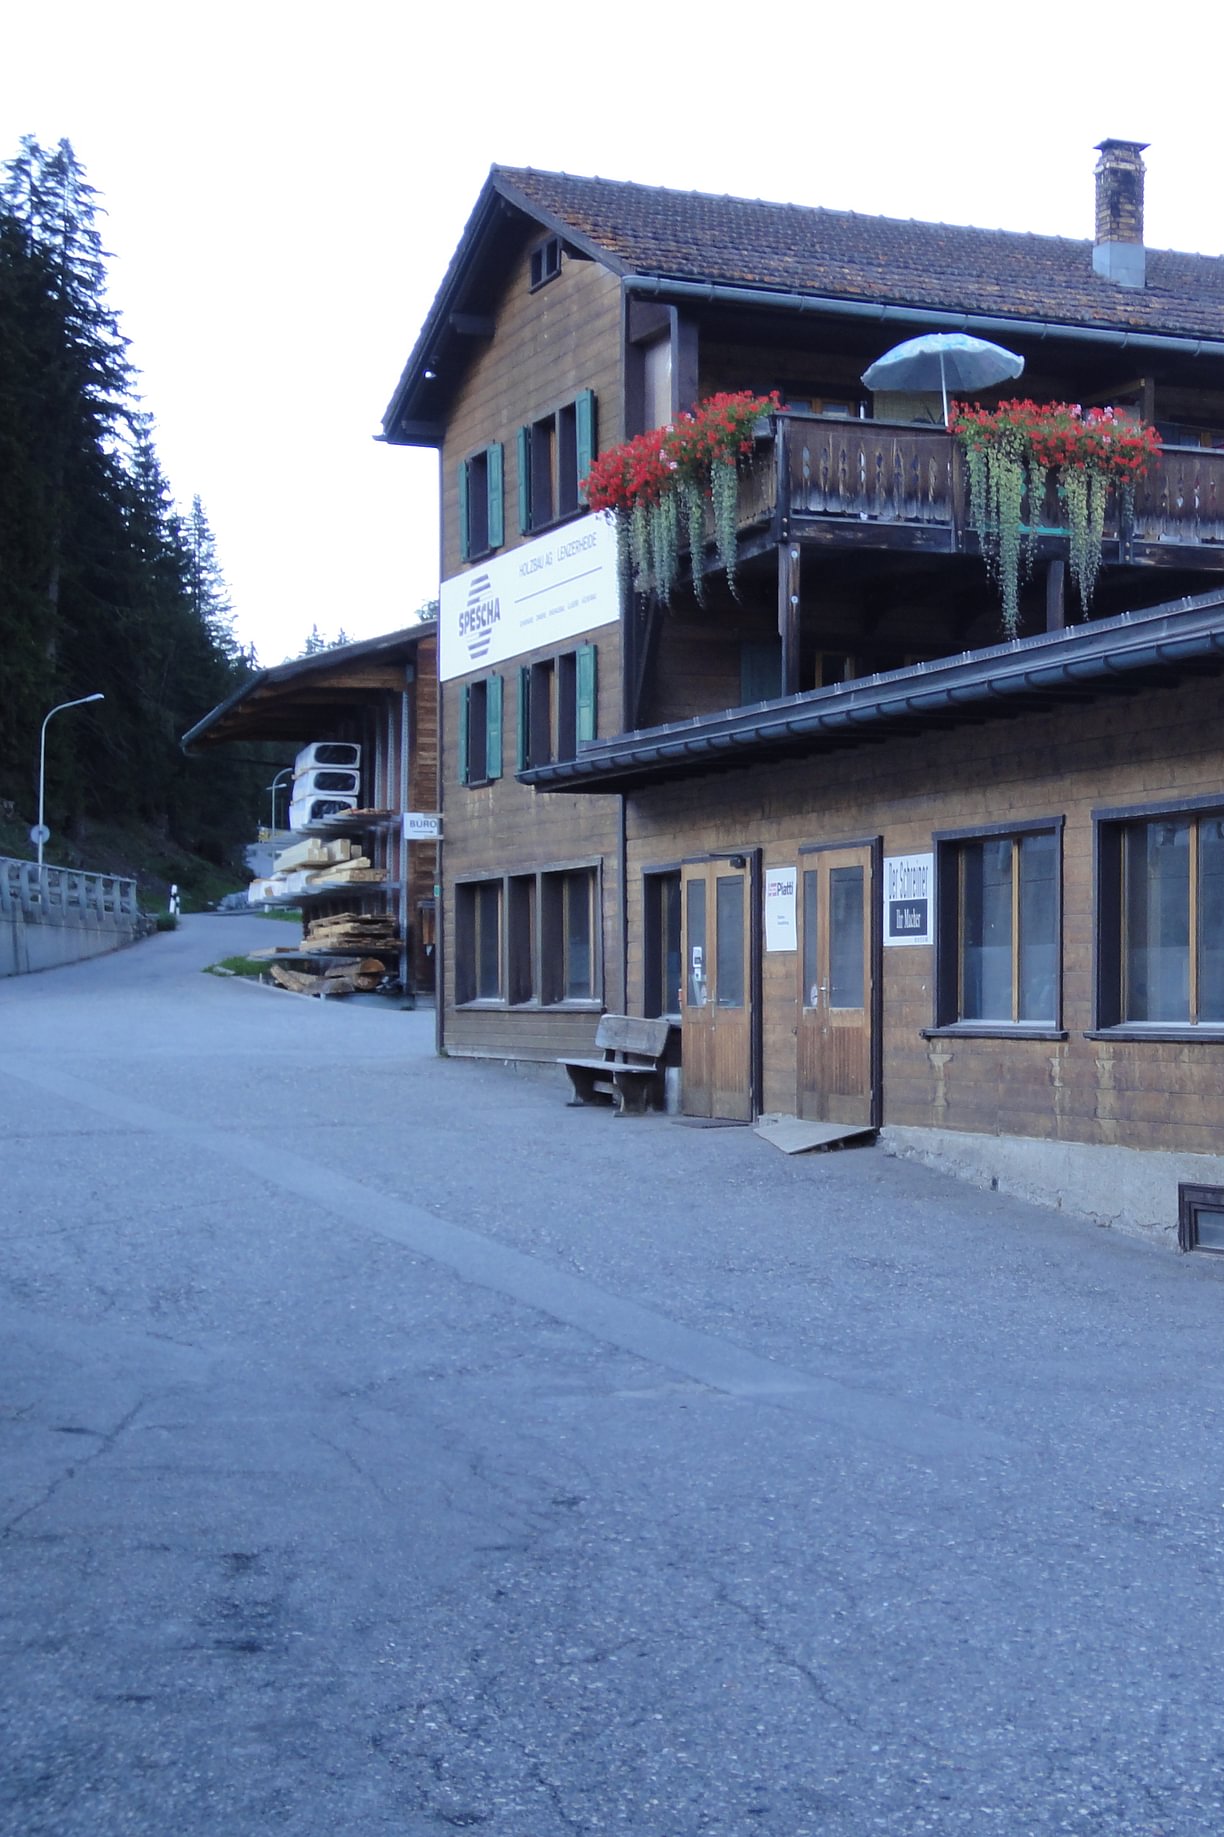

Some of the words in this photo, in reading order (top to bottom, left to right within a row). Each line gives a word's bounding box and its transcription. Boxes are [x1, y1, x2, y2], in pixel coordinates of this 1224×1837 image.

[459, 597, 501, 637] SPESCHA
[777, 881, 793, 896] Piatti
[889, 862, 898, 899] Der
[900, 860, 928, 898] Schreiner
[904, 907, 921, 928] Macher
